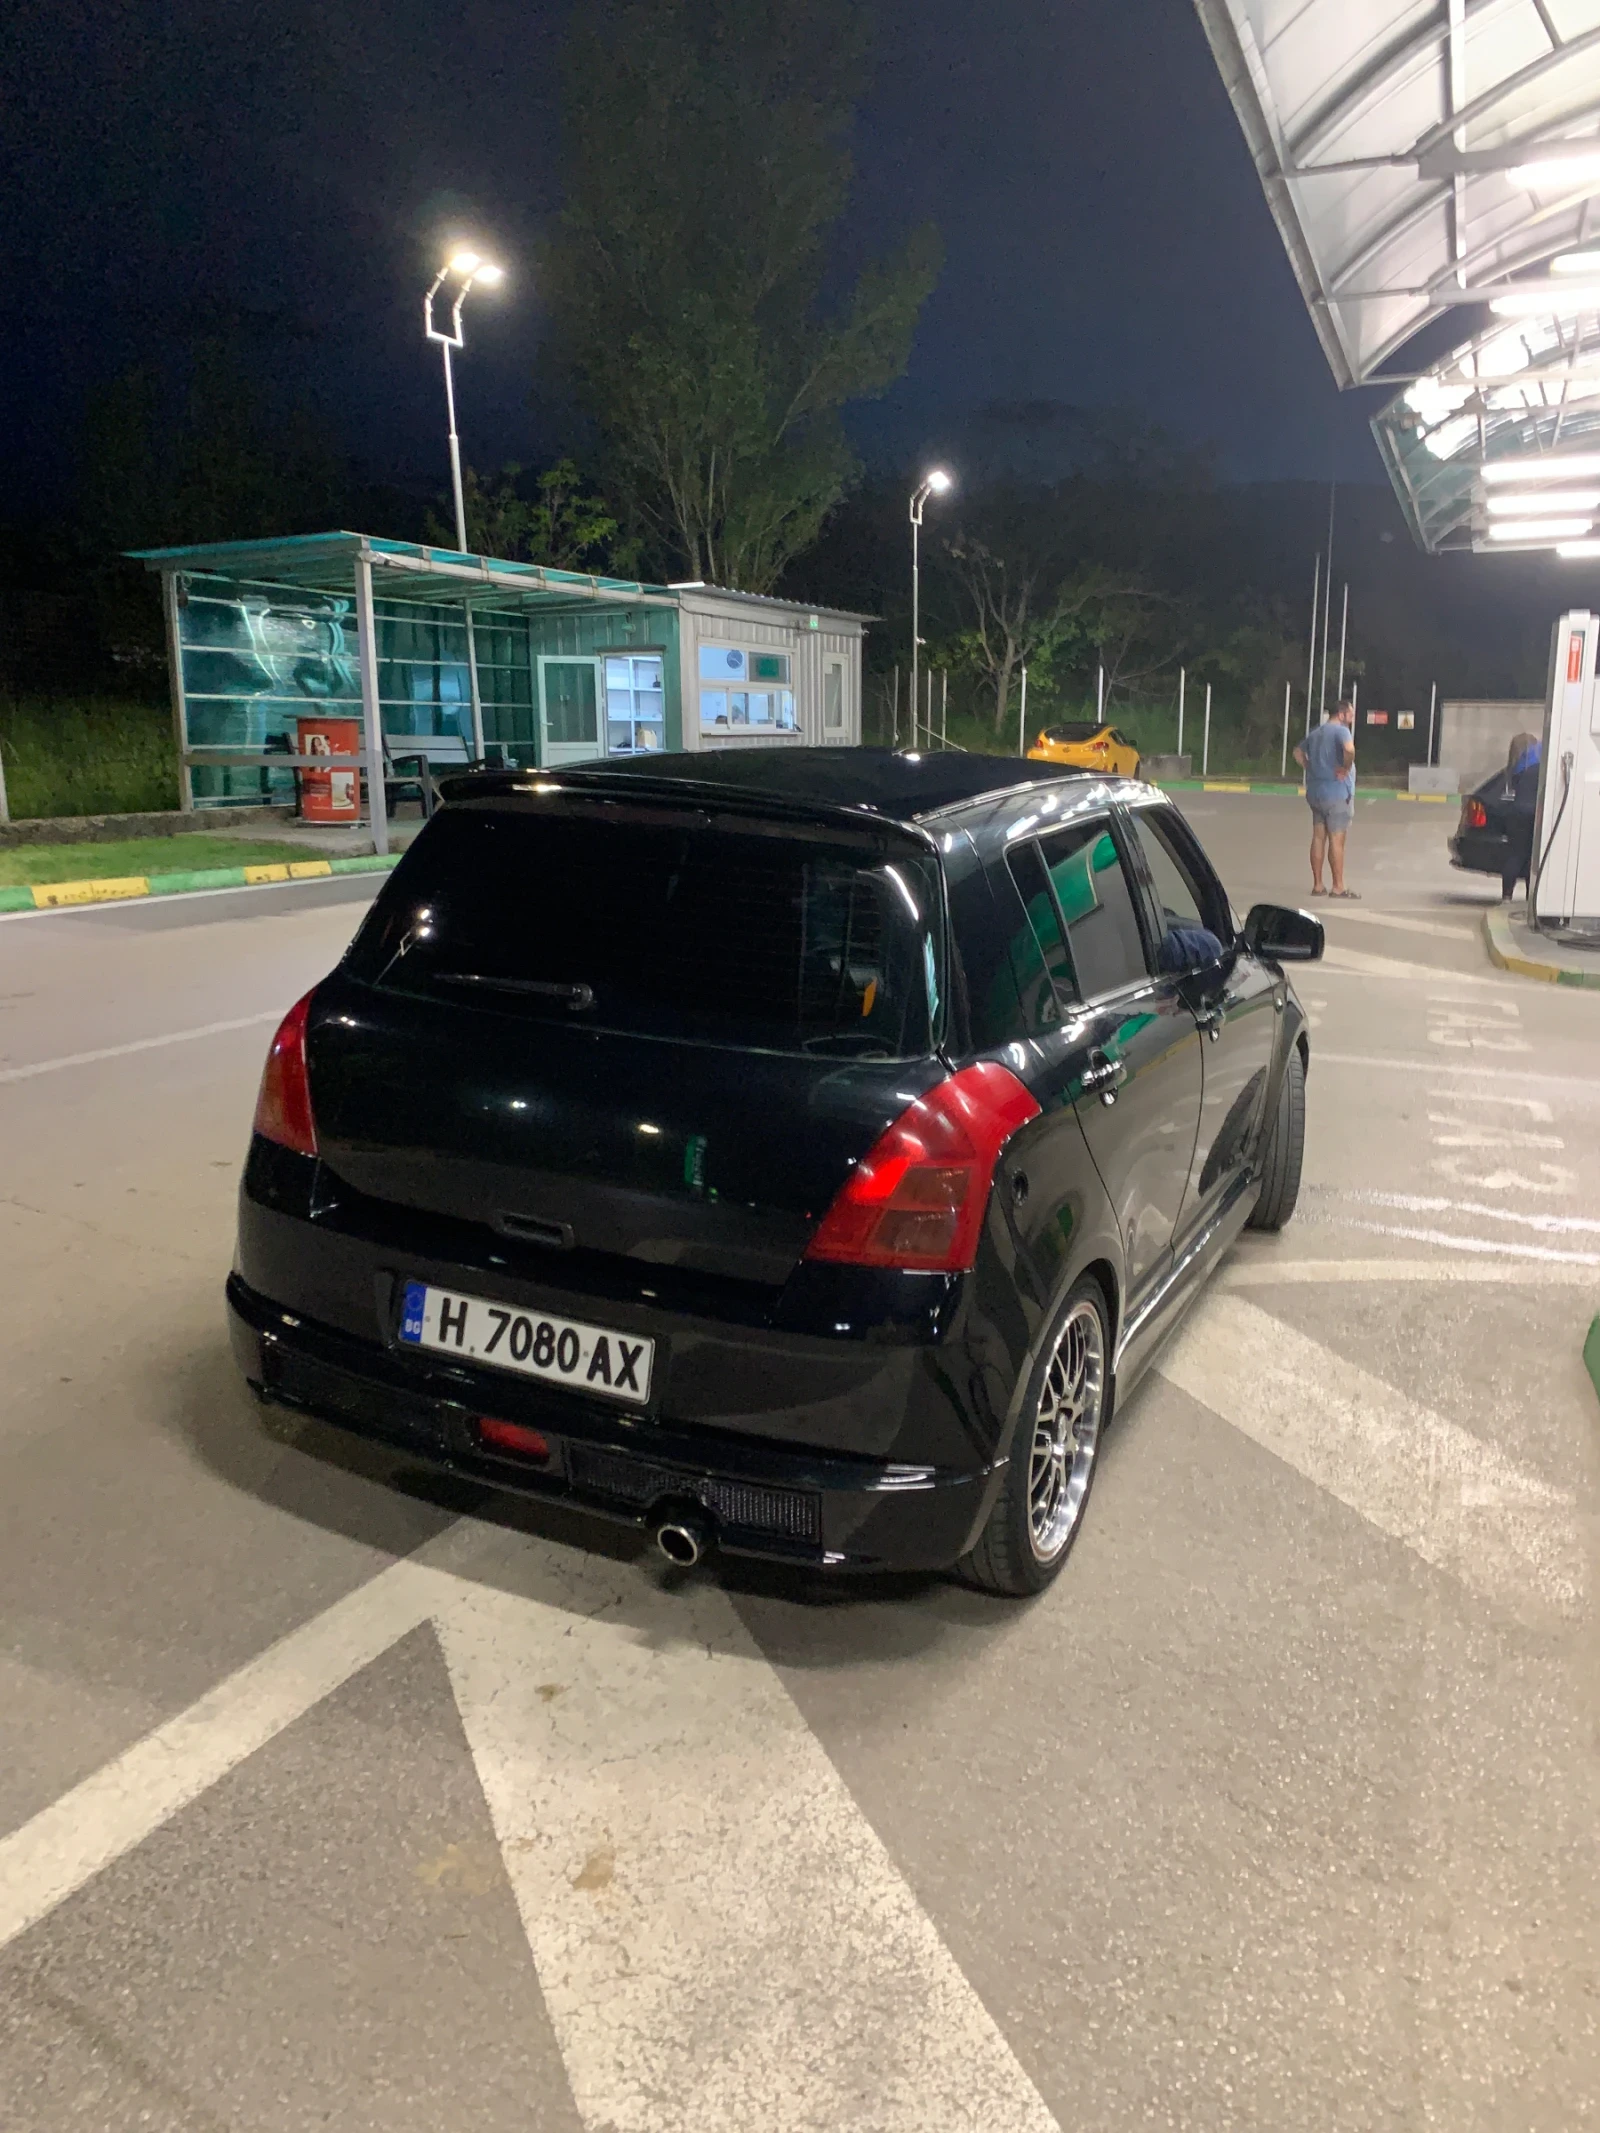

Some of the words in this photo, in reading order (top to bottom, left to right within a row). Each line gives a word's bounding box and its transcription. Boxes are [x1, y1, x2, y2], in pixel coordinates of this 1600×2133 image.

[404, 1318, 421, 1335] BG
[484, 1308, 581, 1374] 7080
[586, 1335, 645, 1393] AX
